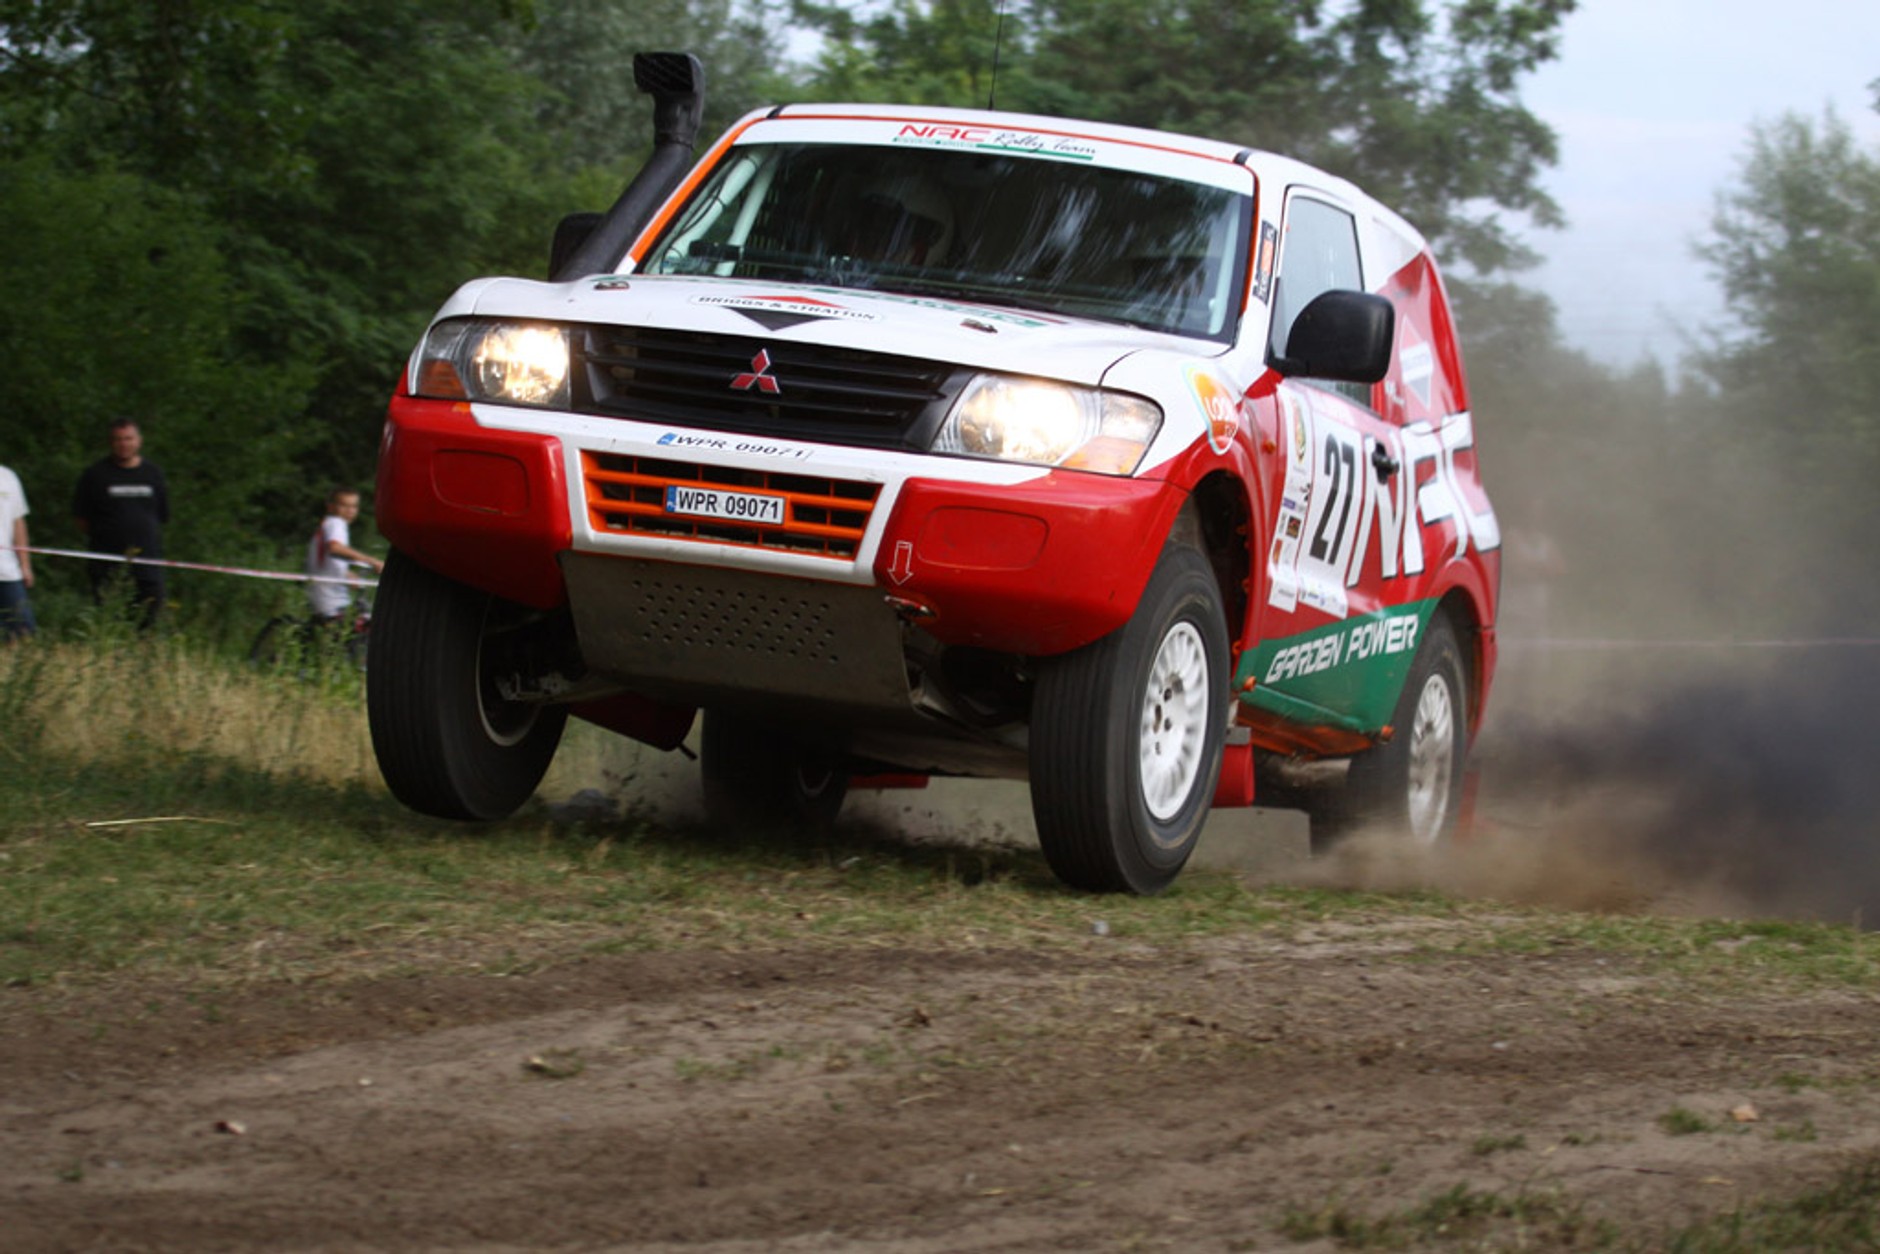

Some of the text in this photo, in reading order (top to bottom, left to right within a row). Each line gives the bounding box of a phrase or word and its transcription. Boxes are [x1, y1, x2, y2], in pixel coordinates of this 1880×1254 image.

[994, 132, 1044, 154] Rally
[1052, 137, 1096, 155] Team
[676, 436, 805, 458] WPR 09071
[678, 490, 779, 520] WPR 09071
[1309, 433, 1355, 566] 27
[1264, 614, 1419, 684] GARDEN POWER
